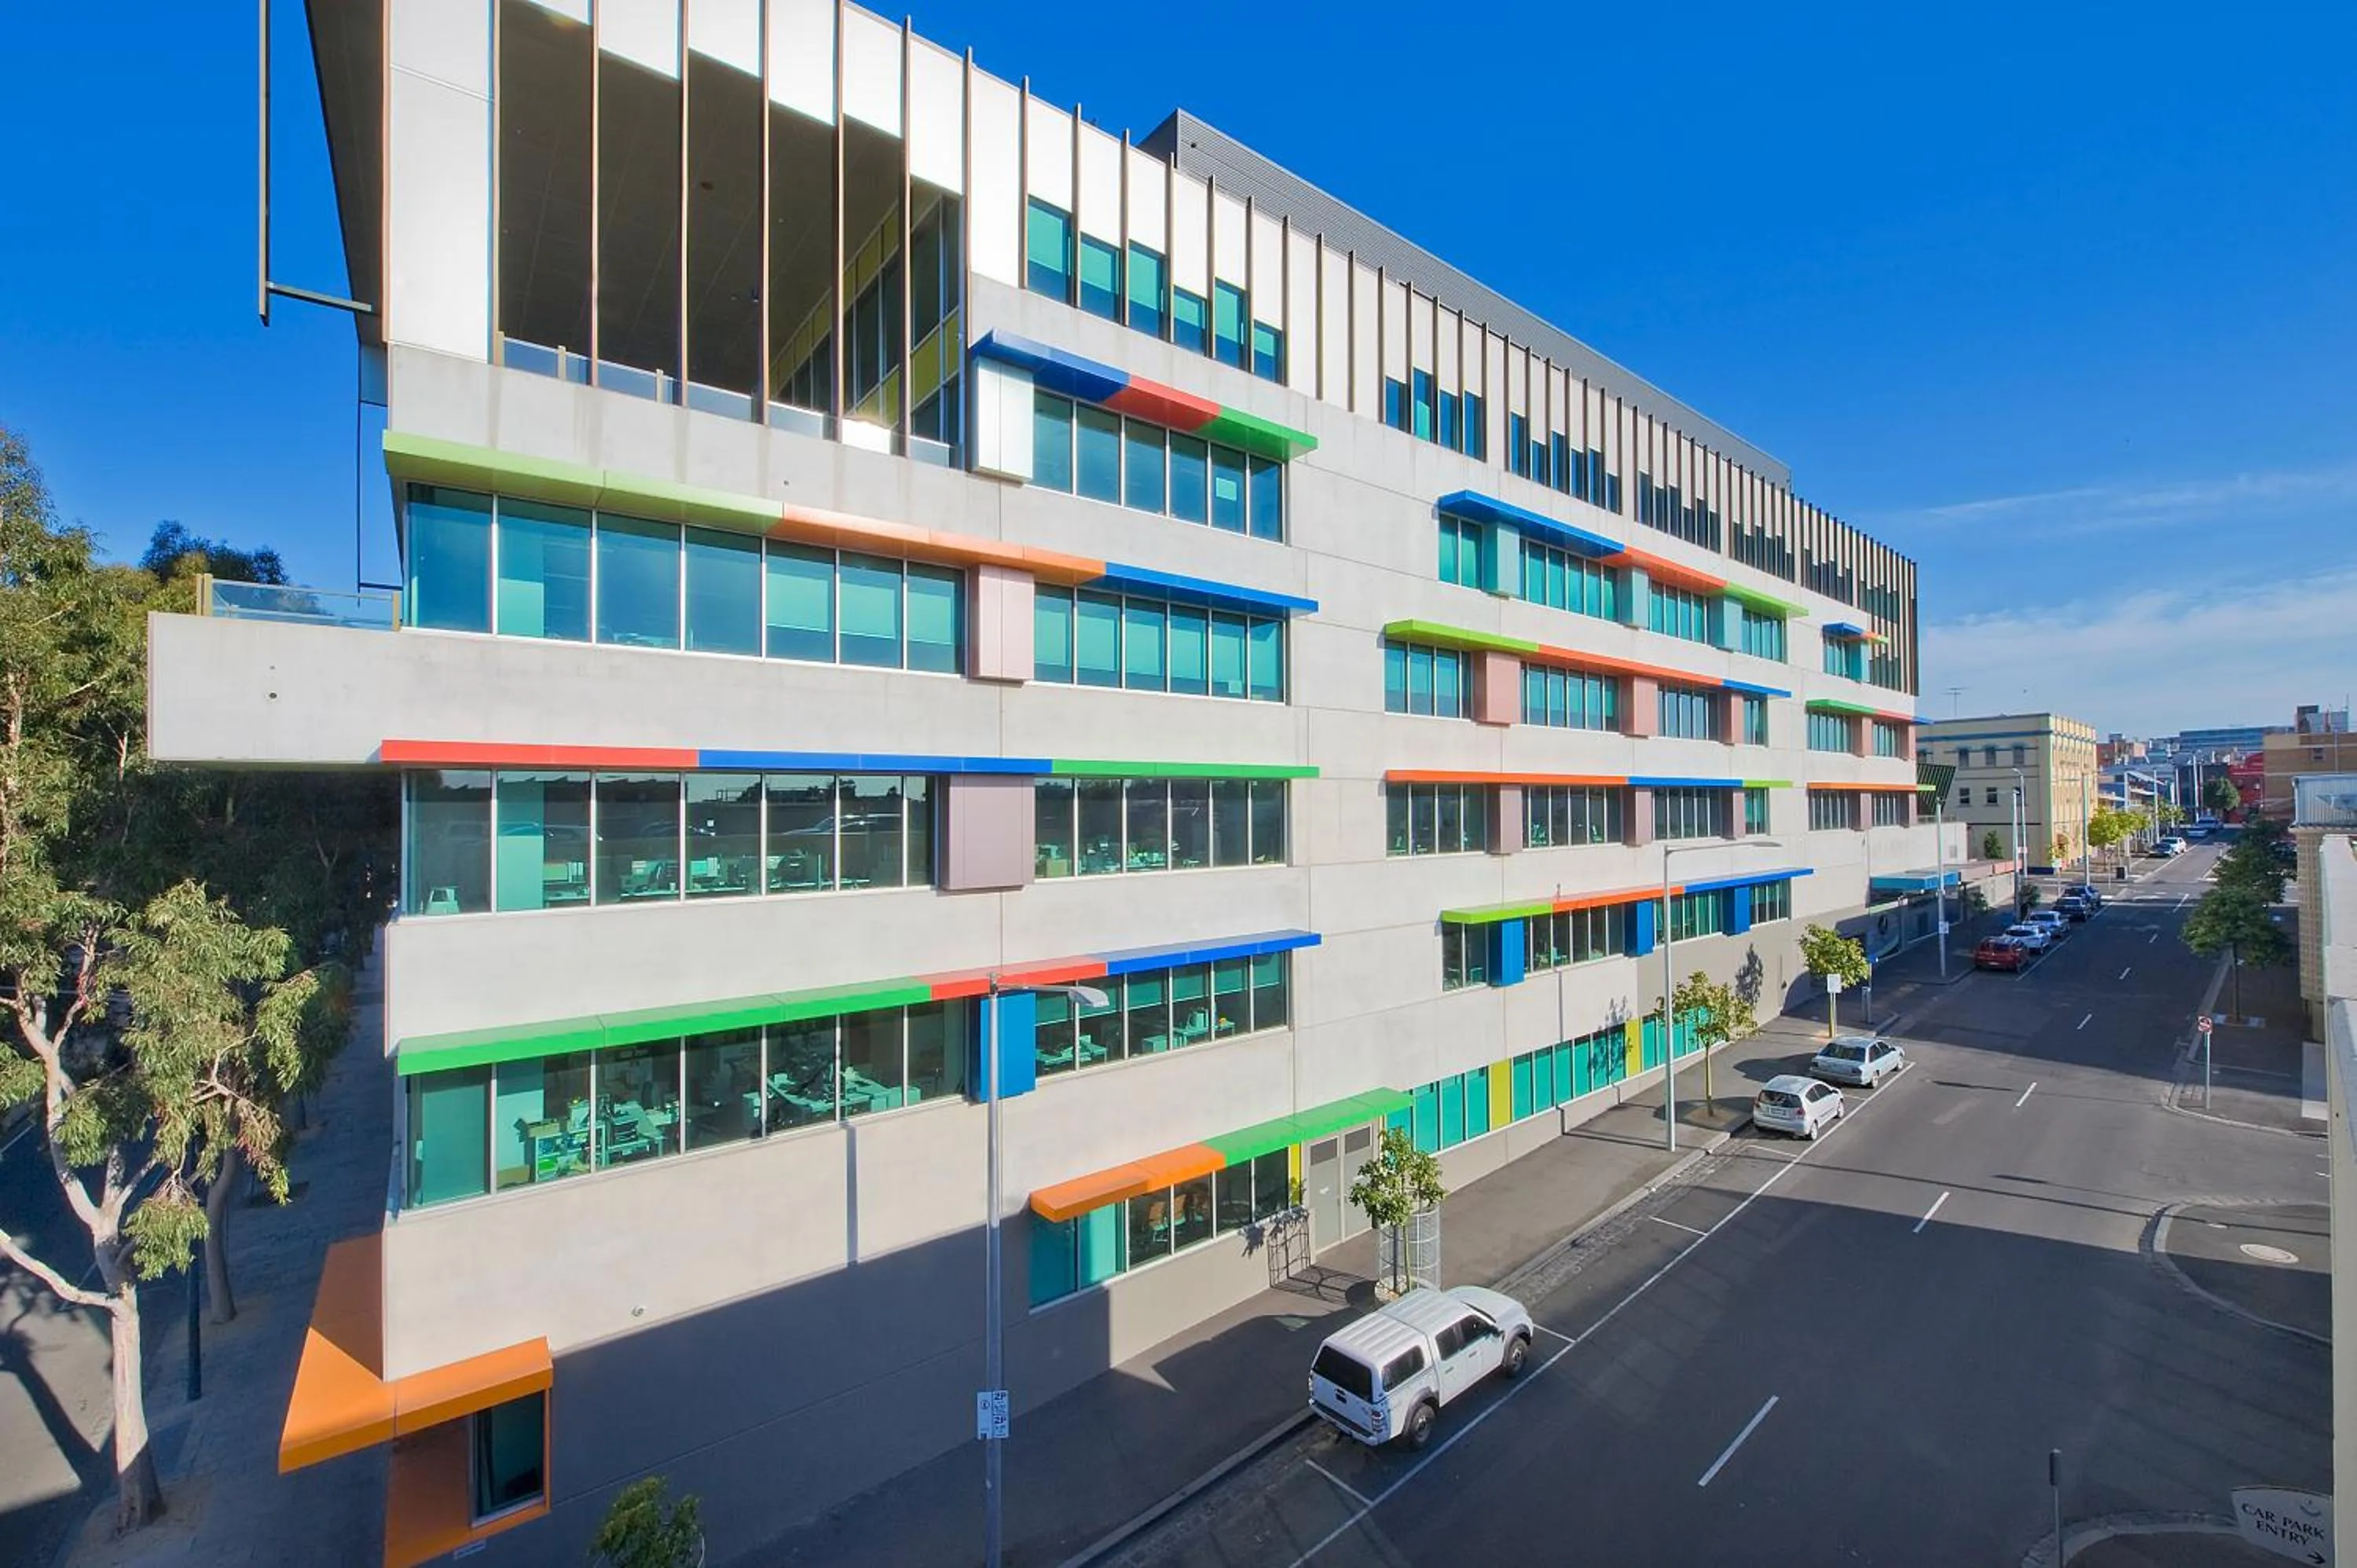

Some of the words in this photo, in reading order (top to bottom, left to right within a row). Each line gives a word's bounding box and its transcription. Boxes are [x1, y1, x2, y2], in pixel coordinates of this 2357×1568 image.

[2242, 1503, 2275, 1522] CAR
[2282, 1516, 2326, 1541] PARK
[2256, 1520, 2309, 1545] ENTRY
